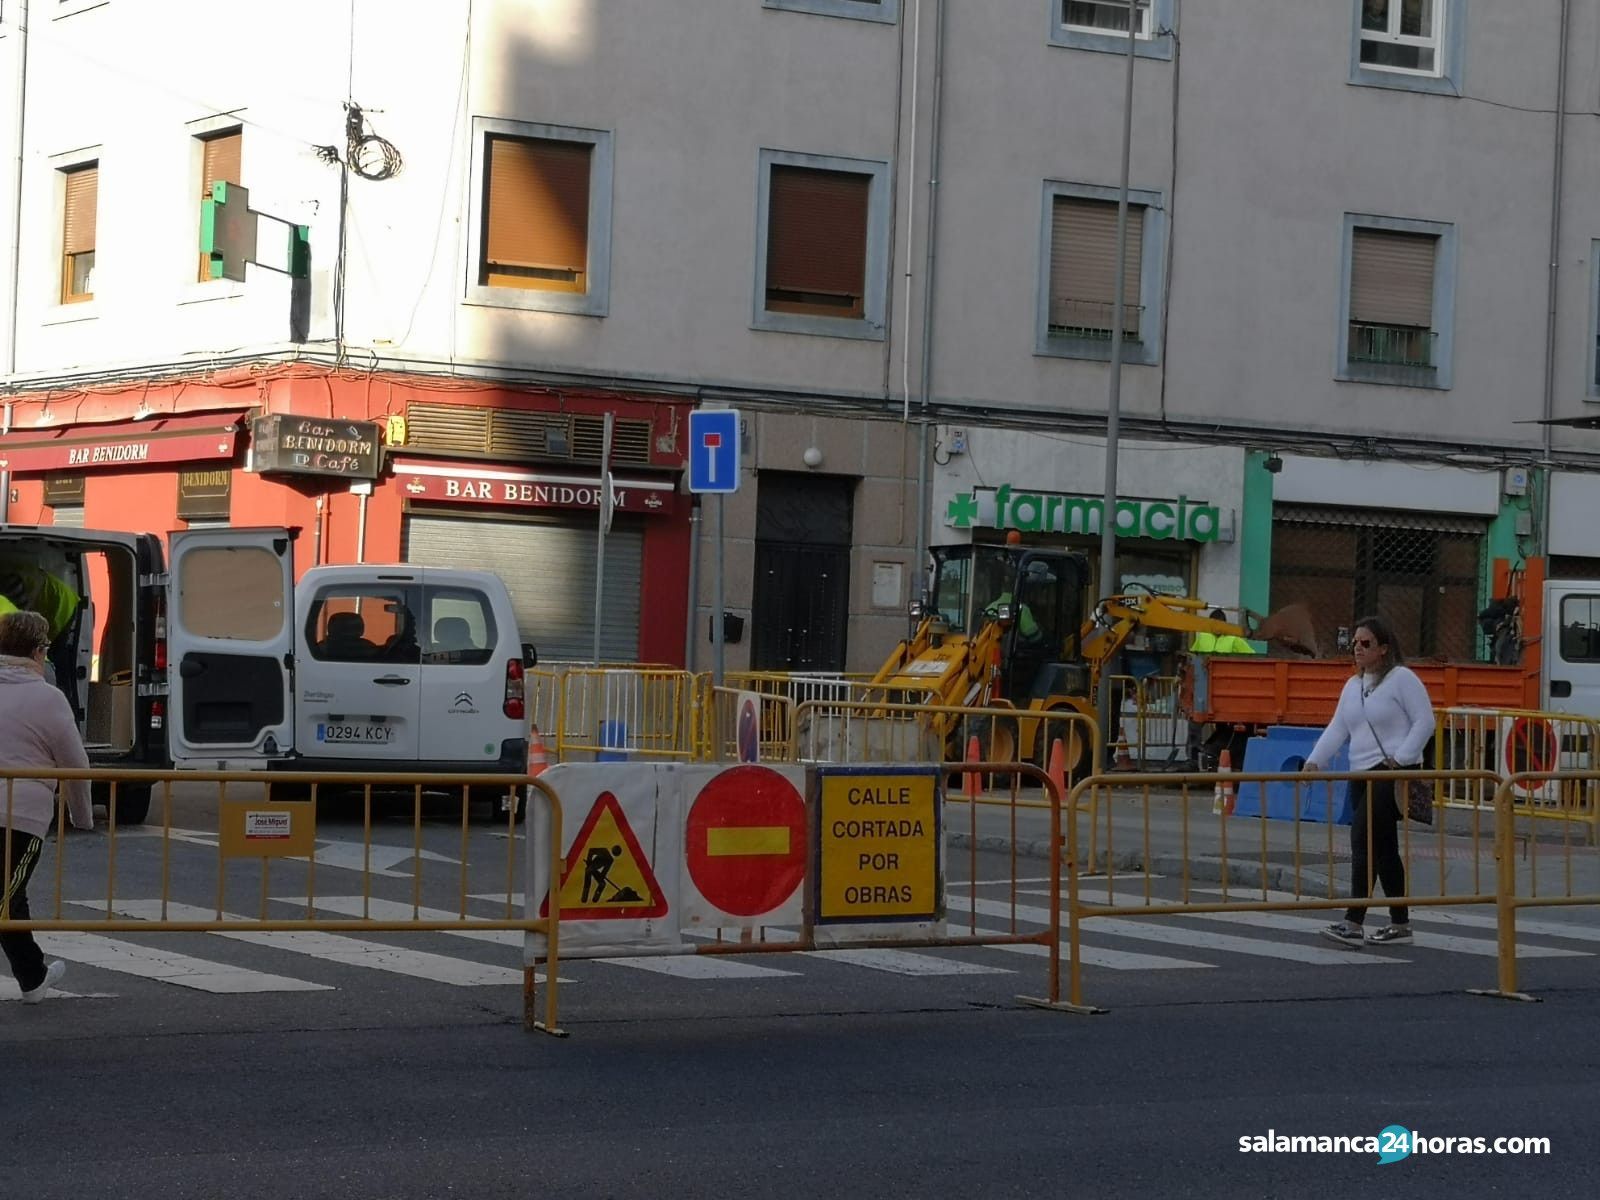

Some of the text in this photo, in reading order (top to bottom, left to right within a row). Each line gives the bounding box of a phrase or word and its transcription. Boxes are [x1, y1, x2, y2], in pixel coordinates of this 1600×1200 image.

[298, 421, 334, 436] Bar
[69, 443, 148, 464] BAR BENIDORM
[285, 435, 371, 455] BENIDORM
[315, 454, 360, 473] Café
[183, 471, 227, 487] BENIDORM
[446, 480, 493, 499] BAR
[995, 483, 1219, 542] farmacia
[327, 726, 392, 740] 0294 KCY
[848, 788, 910, 805] CALLE
[832, 820, 924, 838] CORTADA
[859, 853, 898, 870] POR
[845, 885, 912, 904] OBRAS
